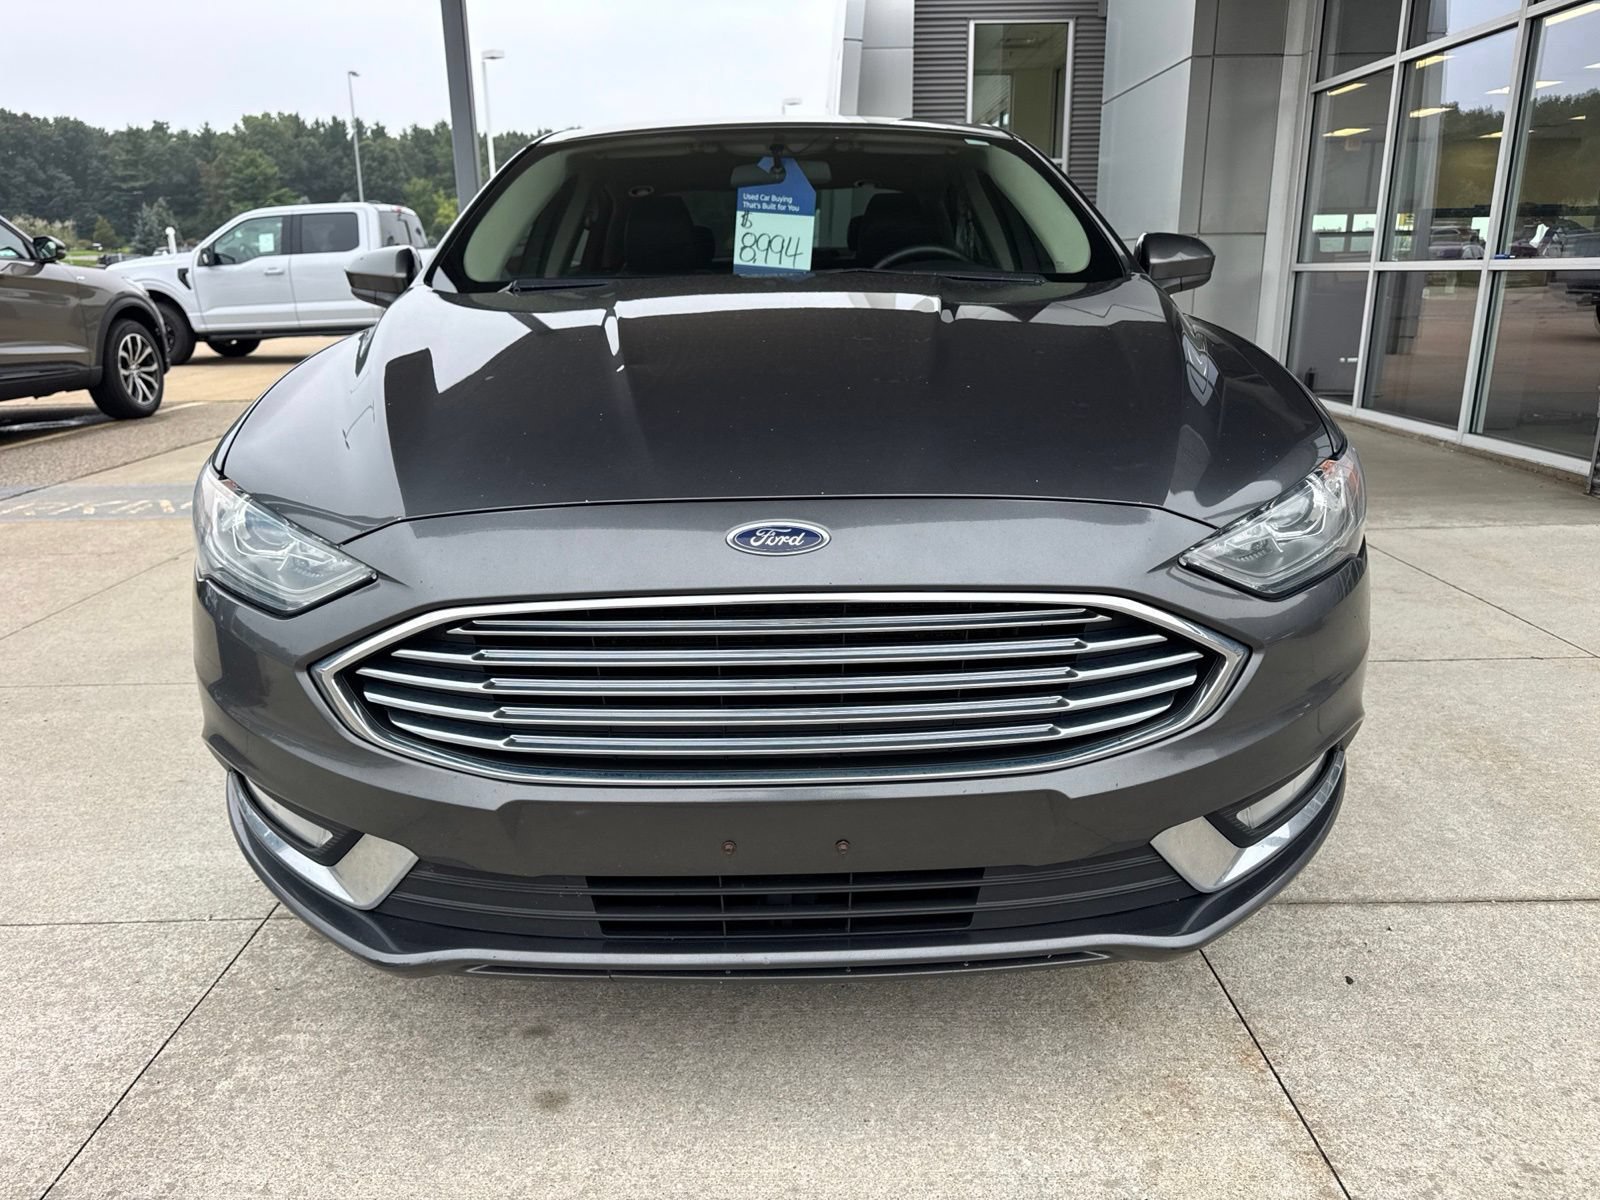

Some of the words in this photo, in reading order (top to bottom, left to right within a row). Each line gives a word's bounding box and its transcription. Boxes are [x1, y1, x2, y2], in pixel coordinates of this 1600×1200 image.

[742, 192, 759, 201] Used
[771, 194, 793, 204] Buying
[743, 201, 761, 209] That's
[762, 202, 777, 210] Built
[777, 203, 787, 211] for
[788, 204, 800, 212] You
[750, 528, 805, 546] Ford
